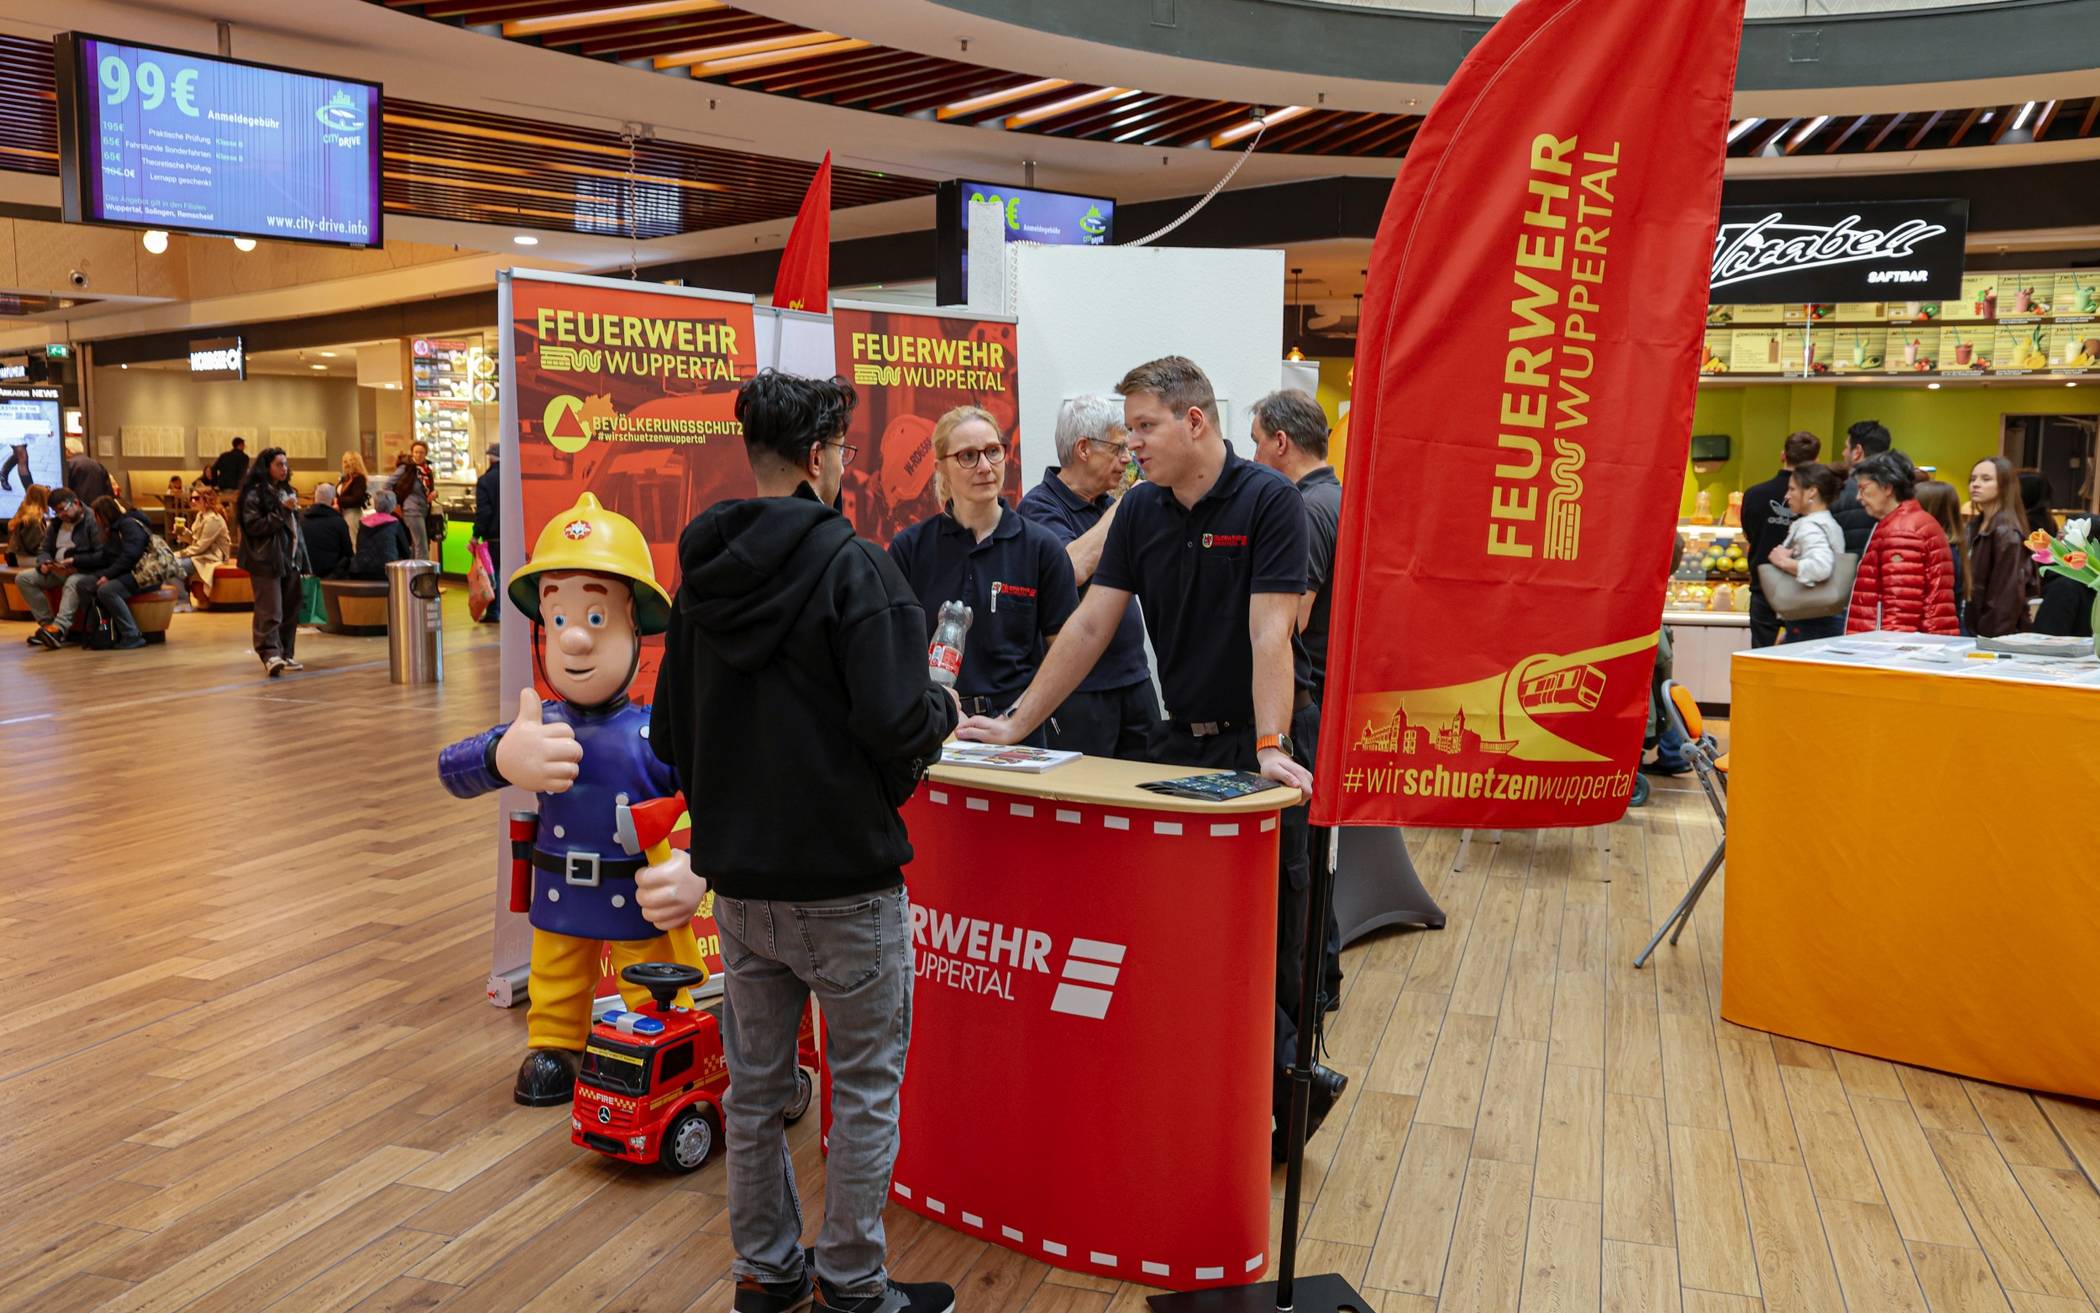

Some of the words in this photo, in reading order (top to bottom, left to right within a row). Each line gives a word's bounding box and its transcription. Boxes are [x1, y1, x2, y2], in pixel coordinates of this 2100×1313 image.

[99, 55, 200, 117] 99€
[207, 109, 280, 129] Anmeldegebühr
[148, 128, 184, 140] Praktische
[185, 133, 211, 145] Prüfung
[266, 213, 368, 236] www.city-drive.info
[1555, 141, 1621, 432] WUPPERTAL
[1867, 270, 1928, 284] SAFTBAR
[537, 307, 738, 354] FEUERWEHR
[852, 332, 1005, 369] FEUERWEHR
[1487, 132, 1579, 559] FEUERWEHR
[605, 350, 741, 382] WUPPERTAL
[903, 365, 1006, 392] WUPPERTAL
[31, 389, 59, 398] NEWS
[592, 413, 744, 436] BEVÖLKERUNGSSCHUTZ
[597, 432, 706, 444] #wirschuetzenwuppertal
[1343, 761, 1635, 806] #wirschuetzenwuppertal
[909, 903, 1053, 974] RWEHR
[913, 948, 1015, 1000] UPPERTAL
[596, 1093, 614, 1105] FIRE
